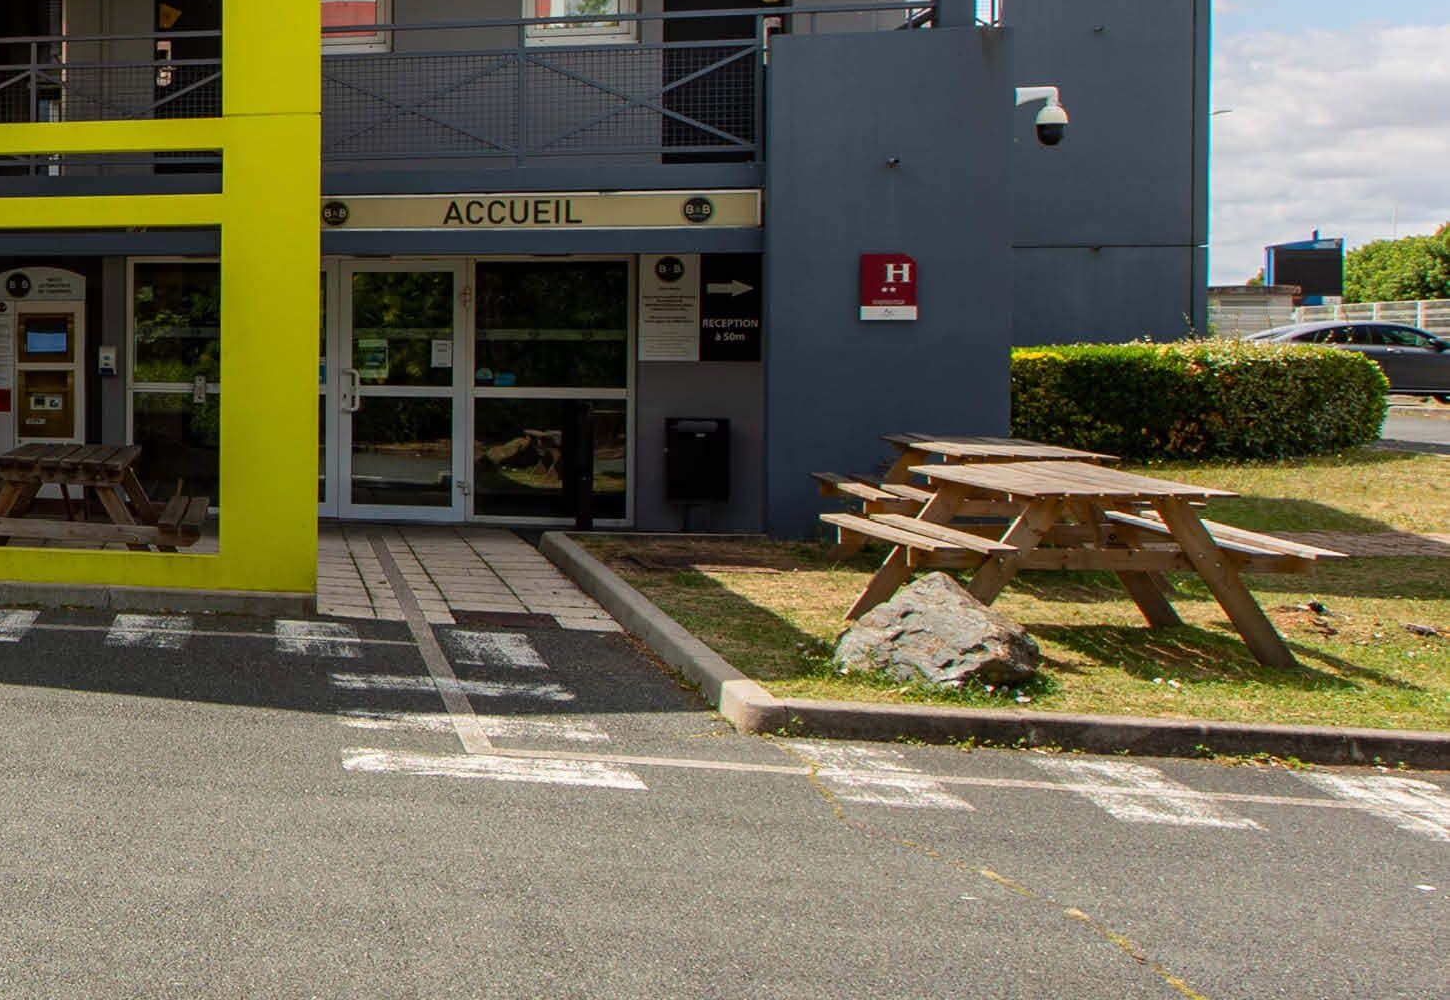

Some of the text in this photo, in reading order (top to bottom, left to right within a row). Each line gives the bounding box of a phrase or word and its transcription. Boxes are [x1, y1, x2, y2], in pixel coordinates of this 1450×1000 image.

[442, 200, 583, 225] ACCUEIL
[885, 263, 912, 283] H
[702, 318, 758, 328] RECEPTION
